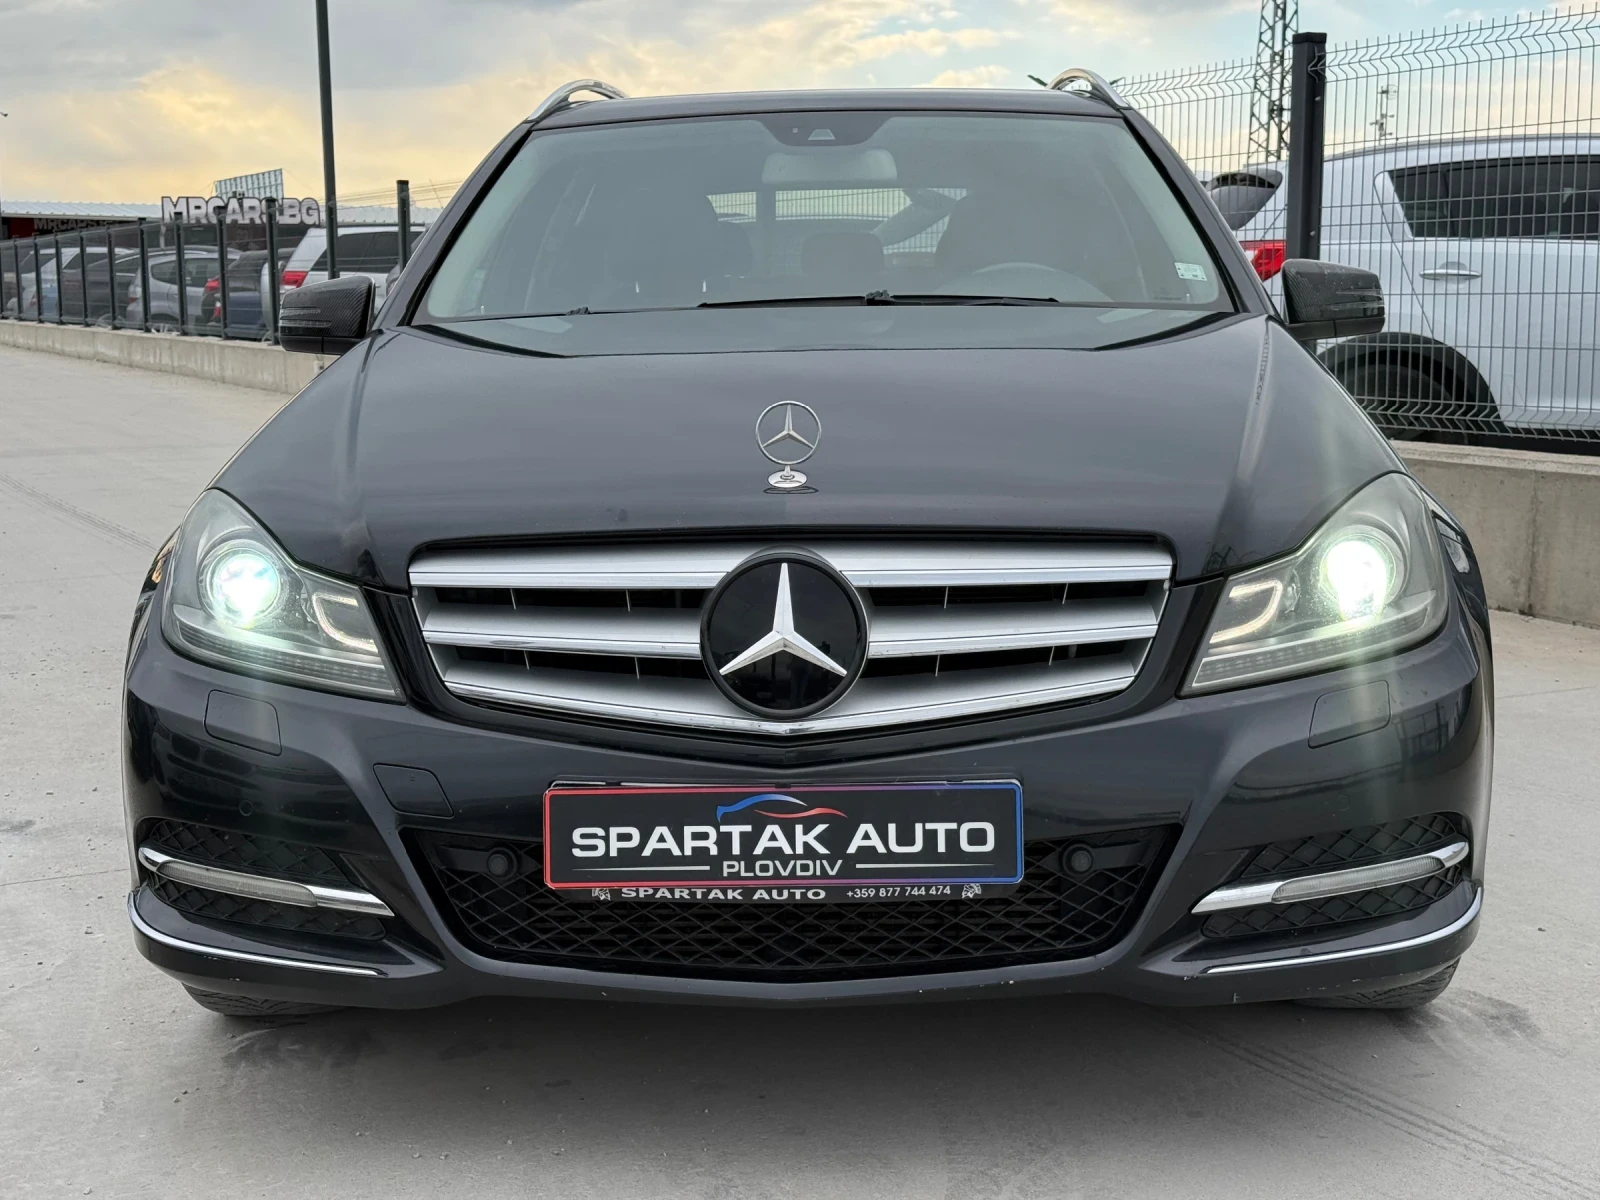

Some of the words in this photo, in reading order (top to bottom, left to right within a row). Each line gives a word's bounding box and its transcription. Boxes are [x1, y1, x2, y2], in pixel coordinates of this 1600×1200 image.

[572, 823, 830, 858] SPARTAK
[846, 821, 996, 854] AUTO
[722, 859, 843, 877] PLOVDIV
[621, 888, 743, 900] SPARTAK
[752, 888, 826, 900] AUTO
[846, 888, 876, 898] +359
[879, 887, 900, 897] 877
[904, 886, 926, 896] 744
[929, 885, 951, 895] 474
